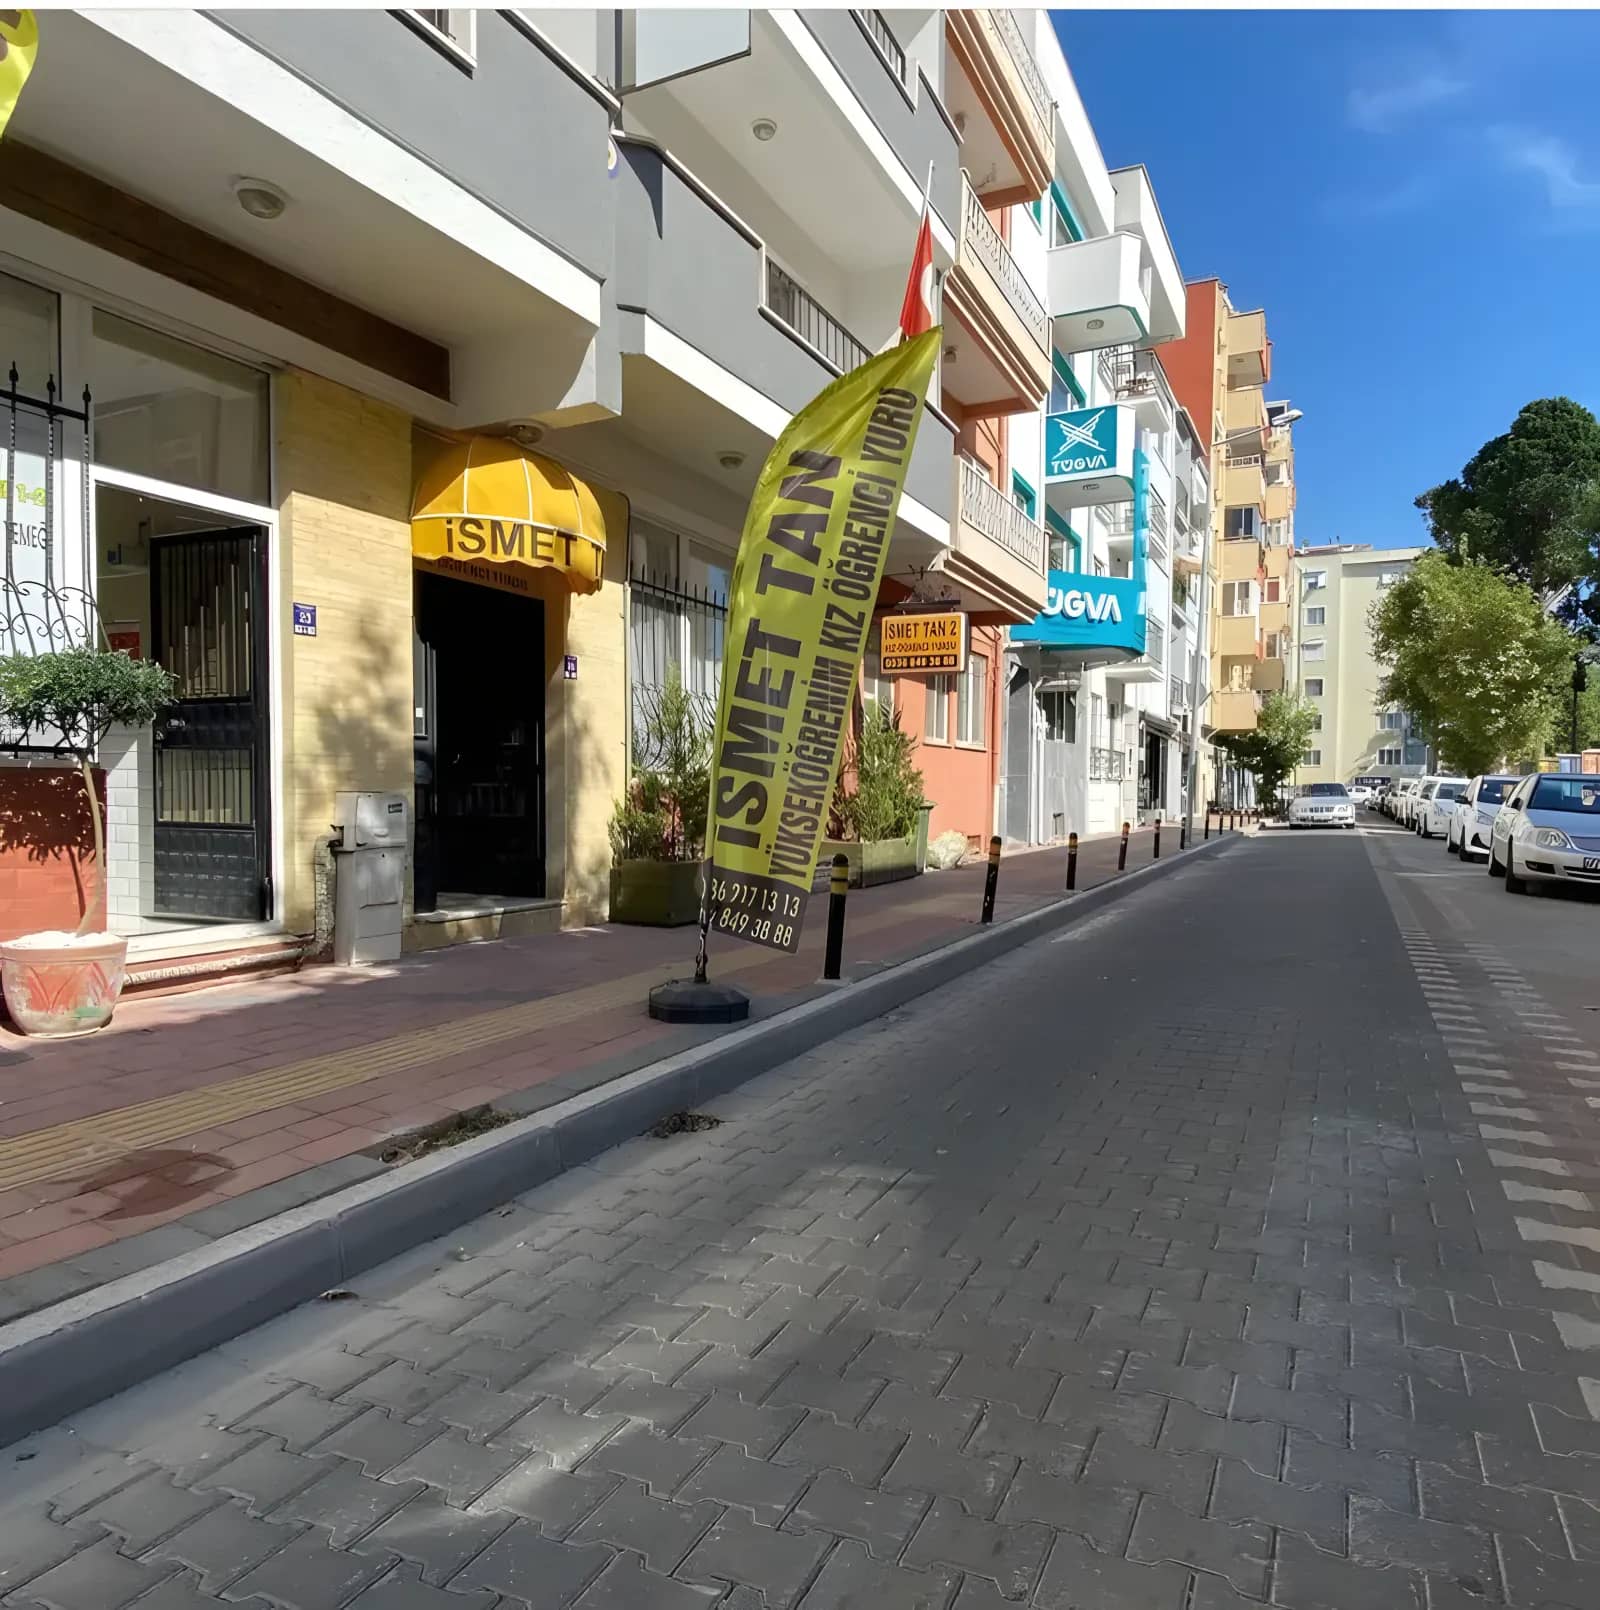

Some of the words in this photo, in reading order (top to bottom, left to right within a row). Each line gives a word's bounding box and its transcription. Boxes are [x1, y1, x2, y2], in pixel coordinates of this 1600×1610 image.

[754, 449, 842, 596] TAN
[822, 468, 897, 602] ÖĞRENCİ
[819, 602, 866, 654] KIZ
[923, 620, 946, 638] TAN
[950, 620, 957, 637] 2
[761, 888, 778, 912] 13
[783, 893, 800, 918] 13
[719, 907, 750, 934] 849
[750, 918, 771, 940] 38
[773, 923, 793, 947] 88
